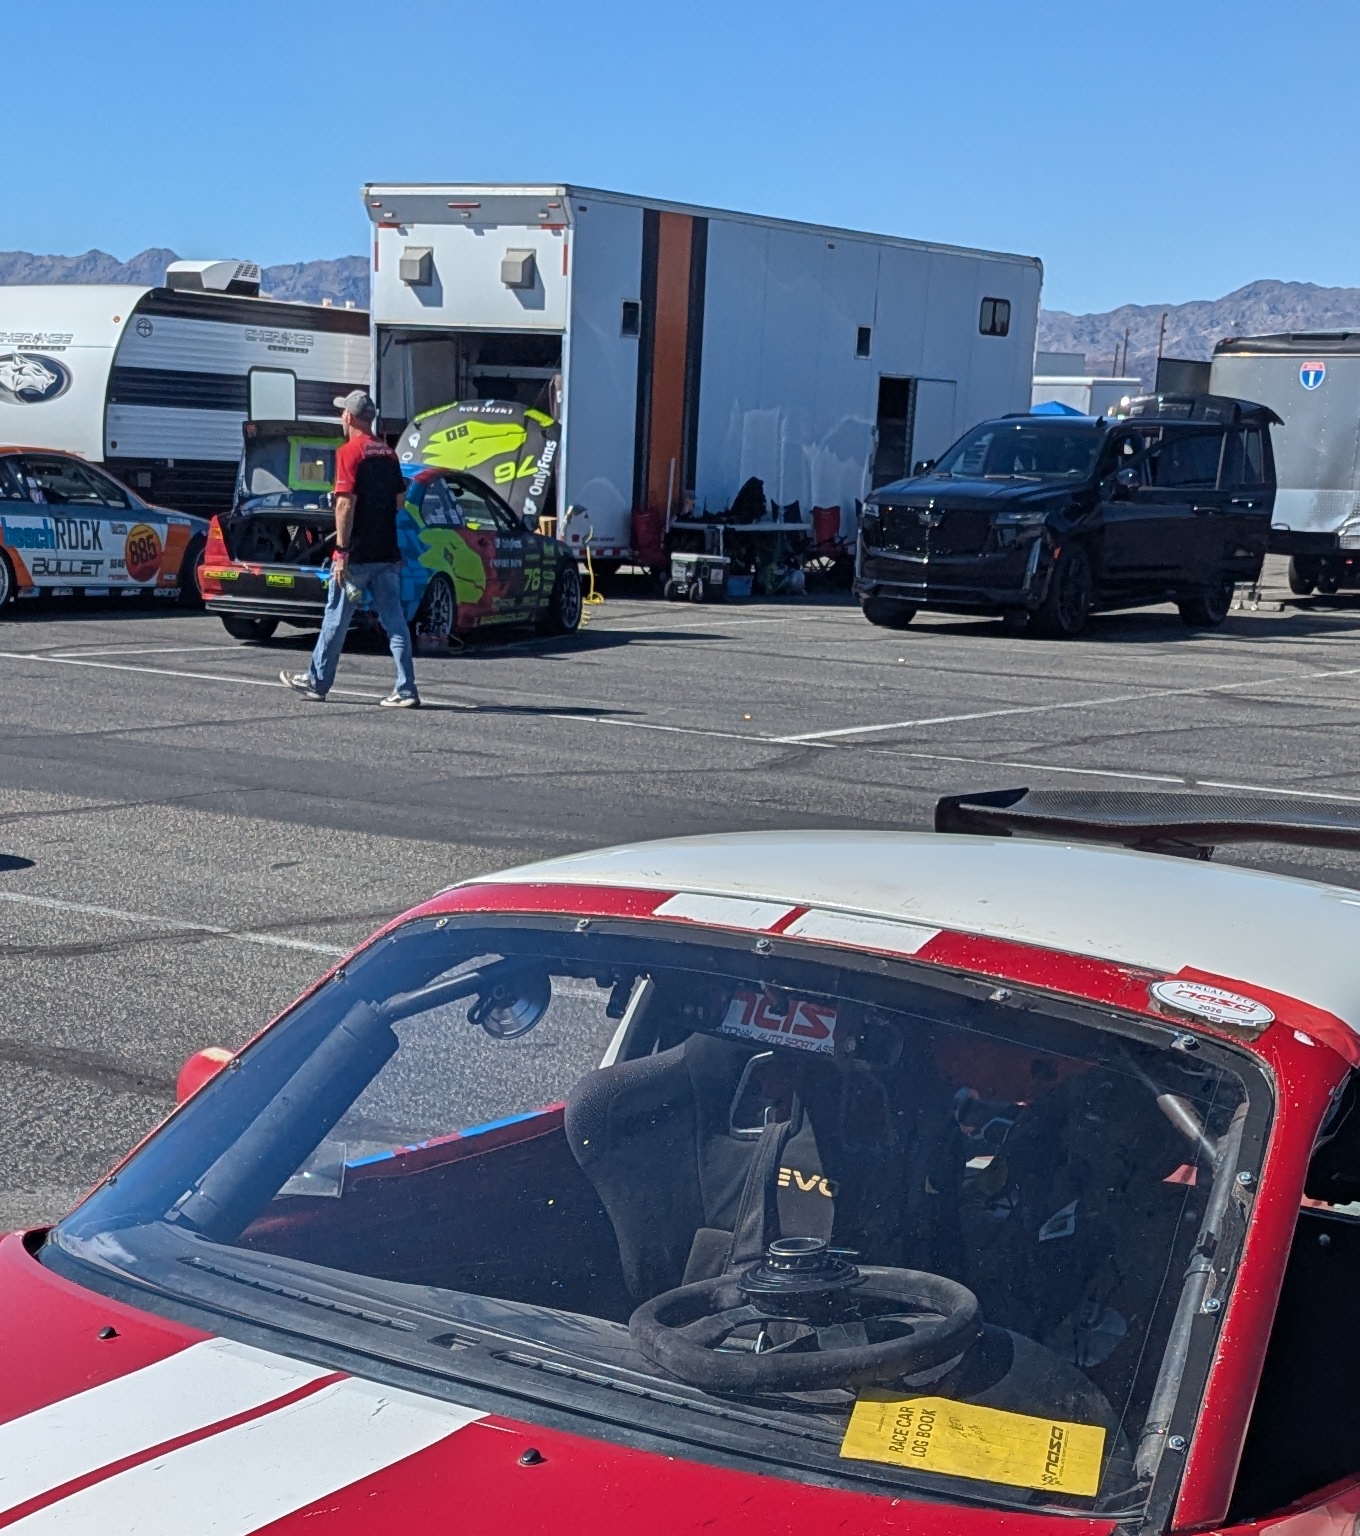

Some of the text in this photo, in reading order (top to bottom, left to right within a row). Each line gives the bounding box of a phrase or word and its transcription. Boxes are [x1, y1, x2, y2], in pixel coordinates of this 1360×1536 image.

[529, 440, 557, 496] OnlyFans
[31, 557, 104, 577] BULLET
[1174, 990, 1256, 1013] nasa
[1178, 983, 1259, 1009] ANNUAL TECH
[889, 1405, 916, 1454] RACE CAR
[910, 1408, 938, 1458] LOG BOOK
[1044, 1426, 1064, 1477] nasa
